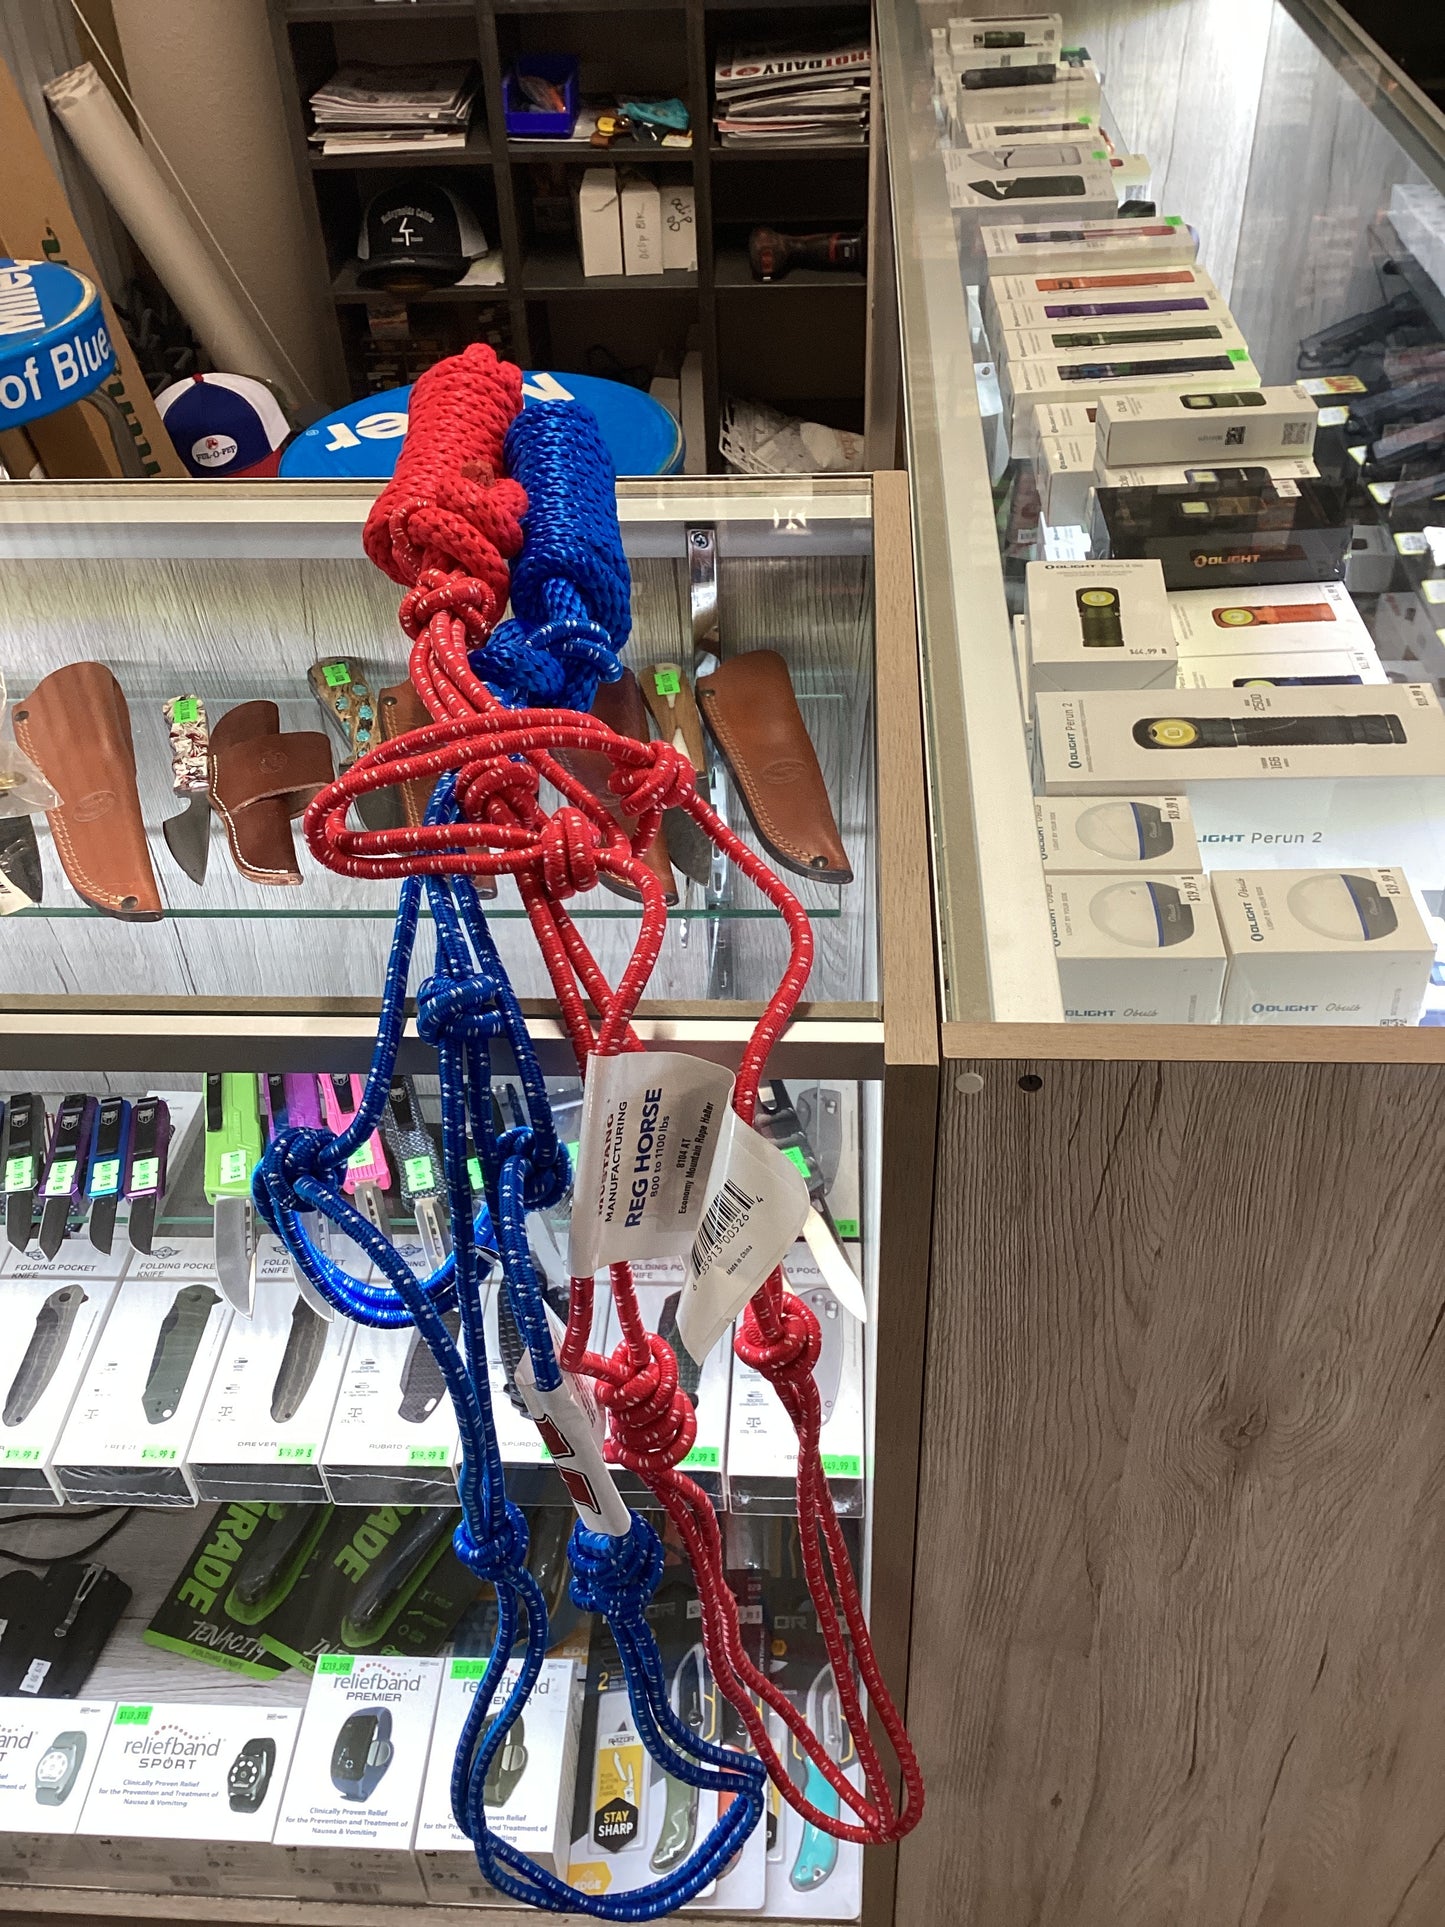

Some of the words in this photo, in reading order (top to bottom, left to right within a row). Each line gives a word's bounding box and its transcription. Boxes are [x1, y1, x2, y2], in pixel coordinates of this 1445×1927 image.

[763, 60, 822, 75] DAILY
[1, 357, 42, 409] of
[50, 327, 110, 391] Blue
[196, 444, 236, 462] FUL-O-PEP
[1207, 554, 1261, 566] OLIGHT
[1065, 708, 1075, 732] Perun
[1069, 733, 1081, 764] OLIGHT
[1251, 832, 1304, 844] Perun
[1312, 832, 1323, 843] 2
[1243, 902, 1261, 935] OLIGHT
[1065, 1009, 1117, 1017] OLIGHT
[1264, 1003, 1318, 1012] OLIGHT
[701, 1101, 714, 1121] Halter
[634, 1088, 662, 1173] HORSE
[659, 1115, 670, 1132] lbs
[695, 1123, 708, 1144] Rope
[655, 1134, 667, 1159] 1100
[681, 1138, 691, 1149] AT
[605, 1101, 628, 1222] MANUFACTURING
[654, 1161, 662, 1173] to
[676, 1149, 688, 1168] 8104
[686, 1145, 702, 1179] Mountain
[650, 1175, 660, 1198] 800
[625, 1178, 648, 1227] REG
[679, 1180, 694, 1214] Economy
[701, 1245, 723, 1276] 35913
[722, 1213, 750, 1245] 00526
[756, 1194, 765, 1204] 4
[15, 1264, 56, 1272] FOLDING
[57, 1264, 96, 1272] POCKET
[140, 1262, 181, 1270] FOLDING
[183, 1262, 215, 1270] POCKE
[726, 1263, 739, 1276] Made
[740, 1244, 753, 1259] China
[187, 1620, 267, 1663] TENACITY
[334, 1673, 421, 1691] reliefband
[598, 1671, 609, 1691] 2
[346, 1691, 402, 1702] PREMIER
[124, 1736, 221, 1756] reliefband
[138, 1757, 197, 1769] SPORT
[123, 1779, 153, 1787] Clinically
[180, 1780, 200, 1788] Relief
[176, 1790, 210, 1798] Treatment
[123, 1798, 148, 1806] Nausea
[157, 1800, 188, 1808] Vomiting
[309, 1807, 340, 1816] Clinically
[342, 1808, 366, 1816] Proven
[368, 1809, 388, 1817] Relief
[506, 1814, 527, 1822] Relief
[603, 1810, 629, 1824] STAY
[310, 1817, 347, 1825] Prevention
[364, 1819, 399, 1827] Treatment
[598, 1822, 634, 1837] SHARP
[345, 1829, 377, 1838] Vomiting
